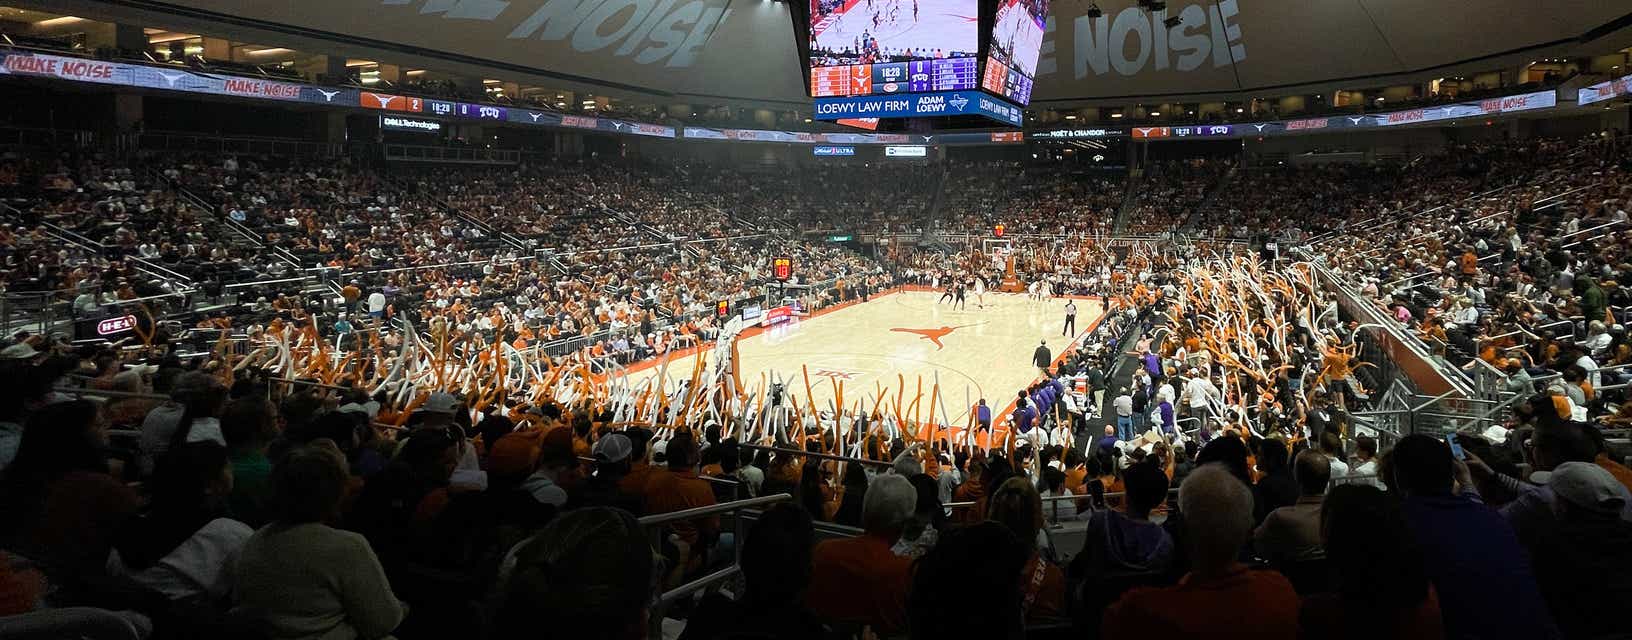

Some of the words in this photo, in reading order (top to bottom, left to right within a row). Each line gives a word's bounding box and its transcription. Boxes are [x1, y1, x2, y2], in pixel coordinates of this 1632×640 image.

[507, 0, 733, 68] NOISE
[1074, 0, 1246, 80] NOISE
[4, 54, 56, 73] MAKE
[61, 61, 113, 79] NOISE
[858, 65, 864, 76] 2
[882, 67, 901, 78] 18:28
[911, 73, 929, 83] TCU
[224, 79, 260, 94] MAKE
[263, 85, 299, 98] NOISE
[412, 99, 418, 109] 2
[918, 96, 944, 105] ADAM
[1503, 97, 1528, 109] NOISE
[480, 107, 500, 119] TCU
[818, 102, 856, 114] LOEWY
[858, 101, 882, 113] LAW
[884, 100, 909, 112] FIRM
[916, 103, 947, 113] LOEWY
[384, 118, 403, 127] DELL
[403, 120, 440, 130] Technologies
[1074, 129, 1105, 137] CHANDON
